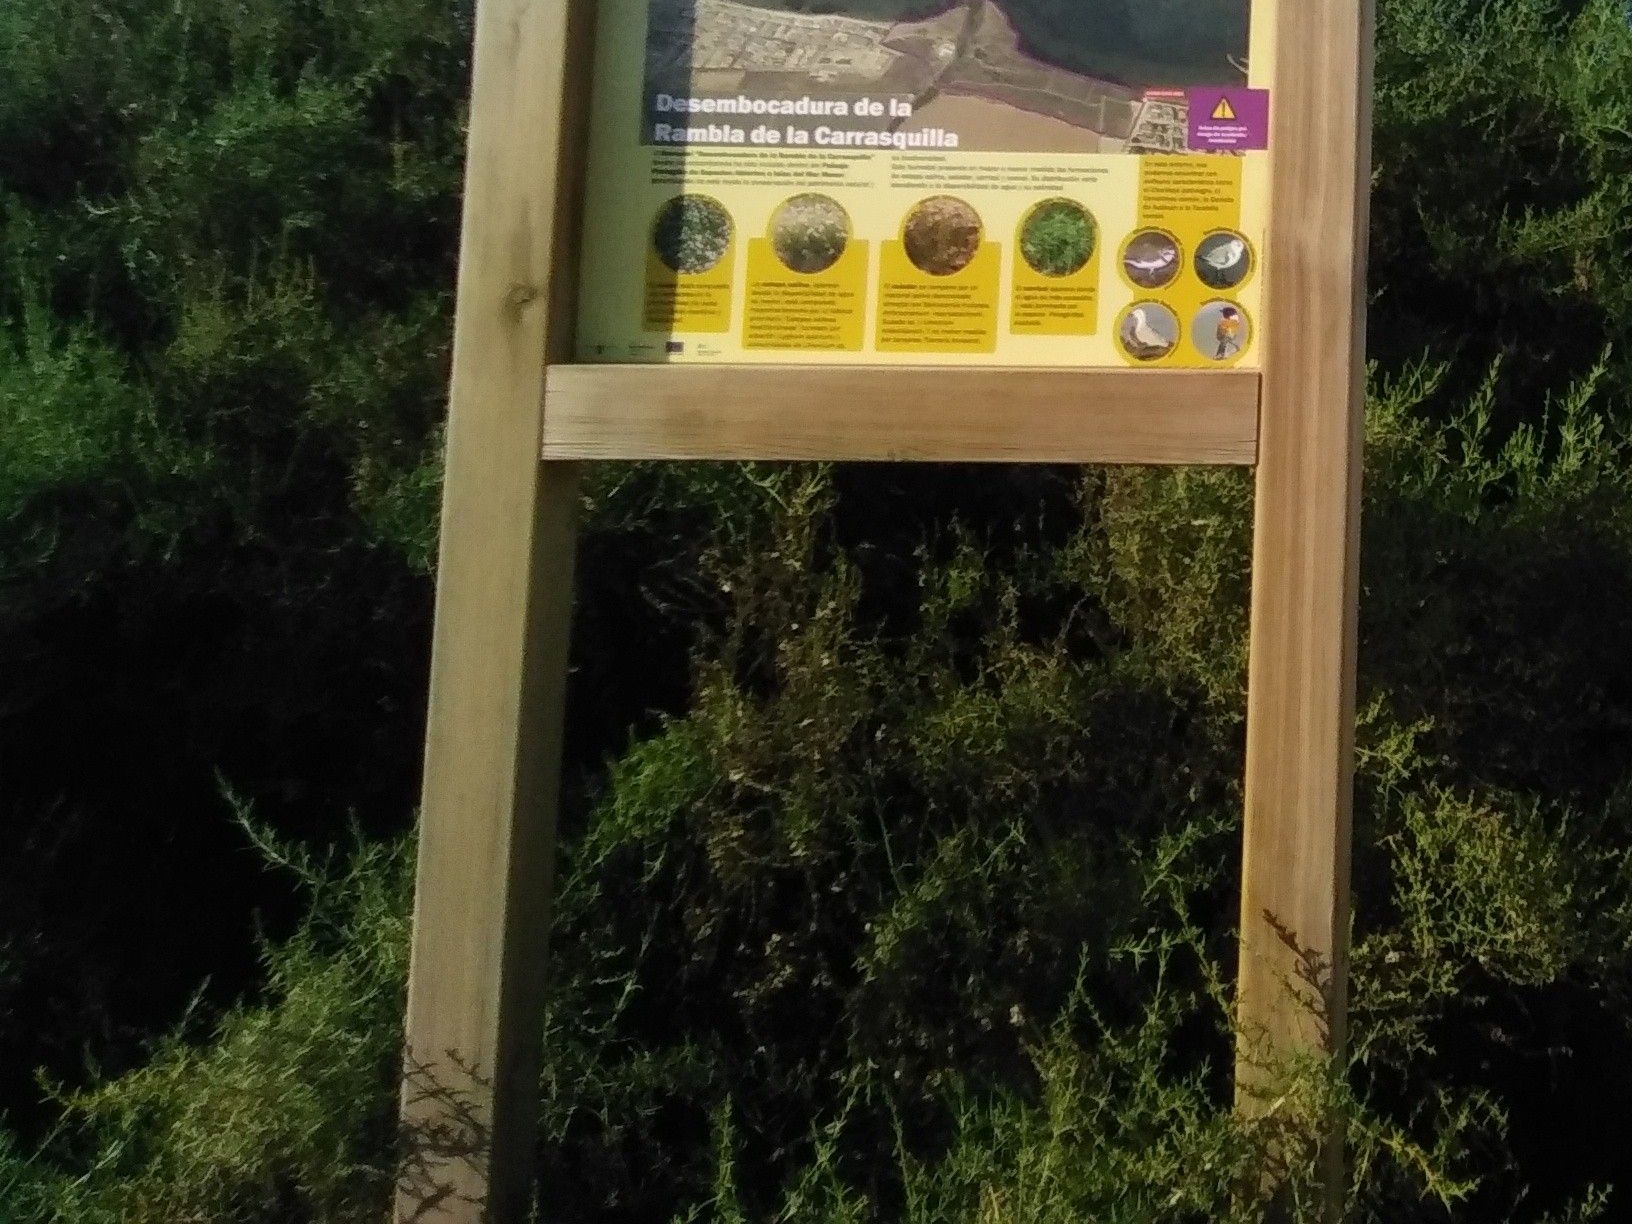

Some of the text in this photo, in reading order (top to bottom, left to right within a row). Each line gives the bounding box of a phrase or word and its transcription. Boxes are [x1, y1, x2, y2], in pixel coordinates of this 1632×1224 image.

[656, 93, 912, 117] Desembocadura de la
[654, 123, 959, 150] Rambla de la Carrasquilla
